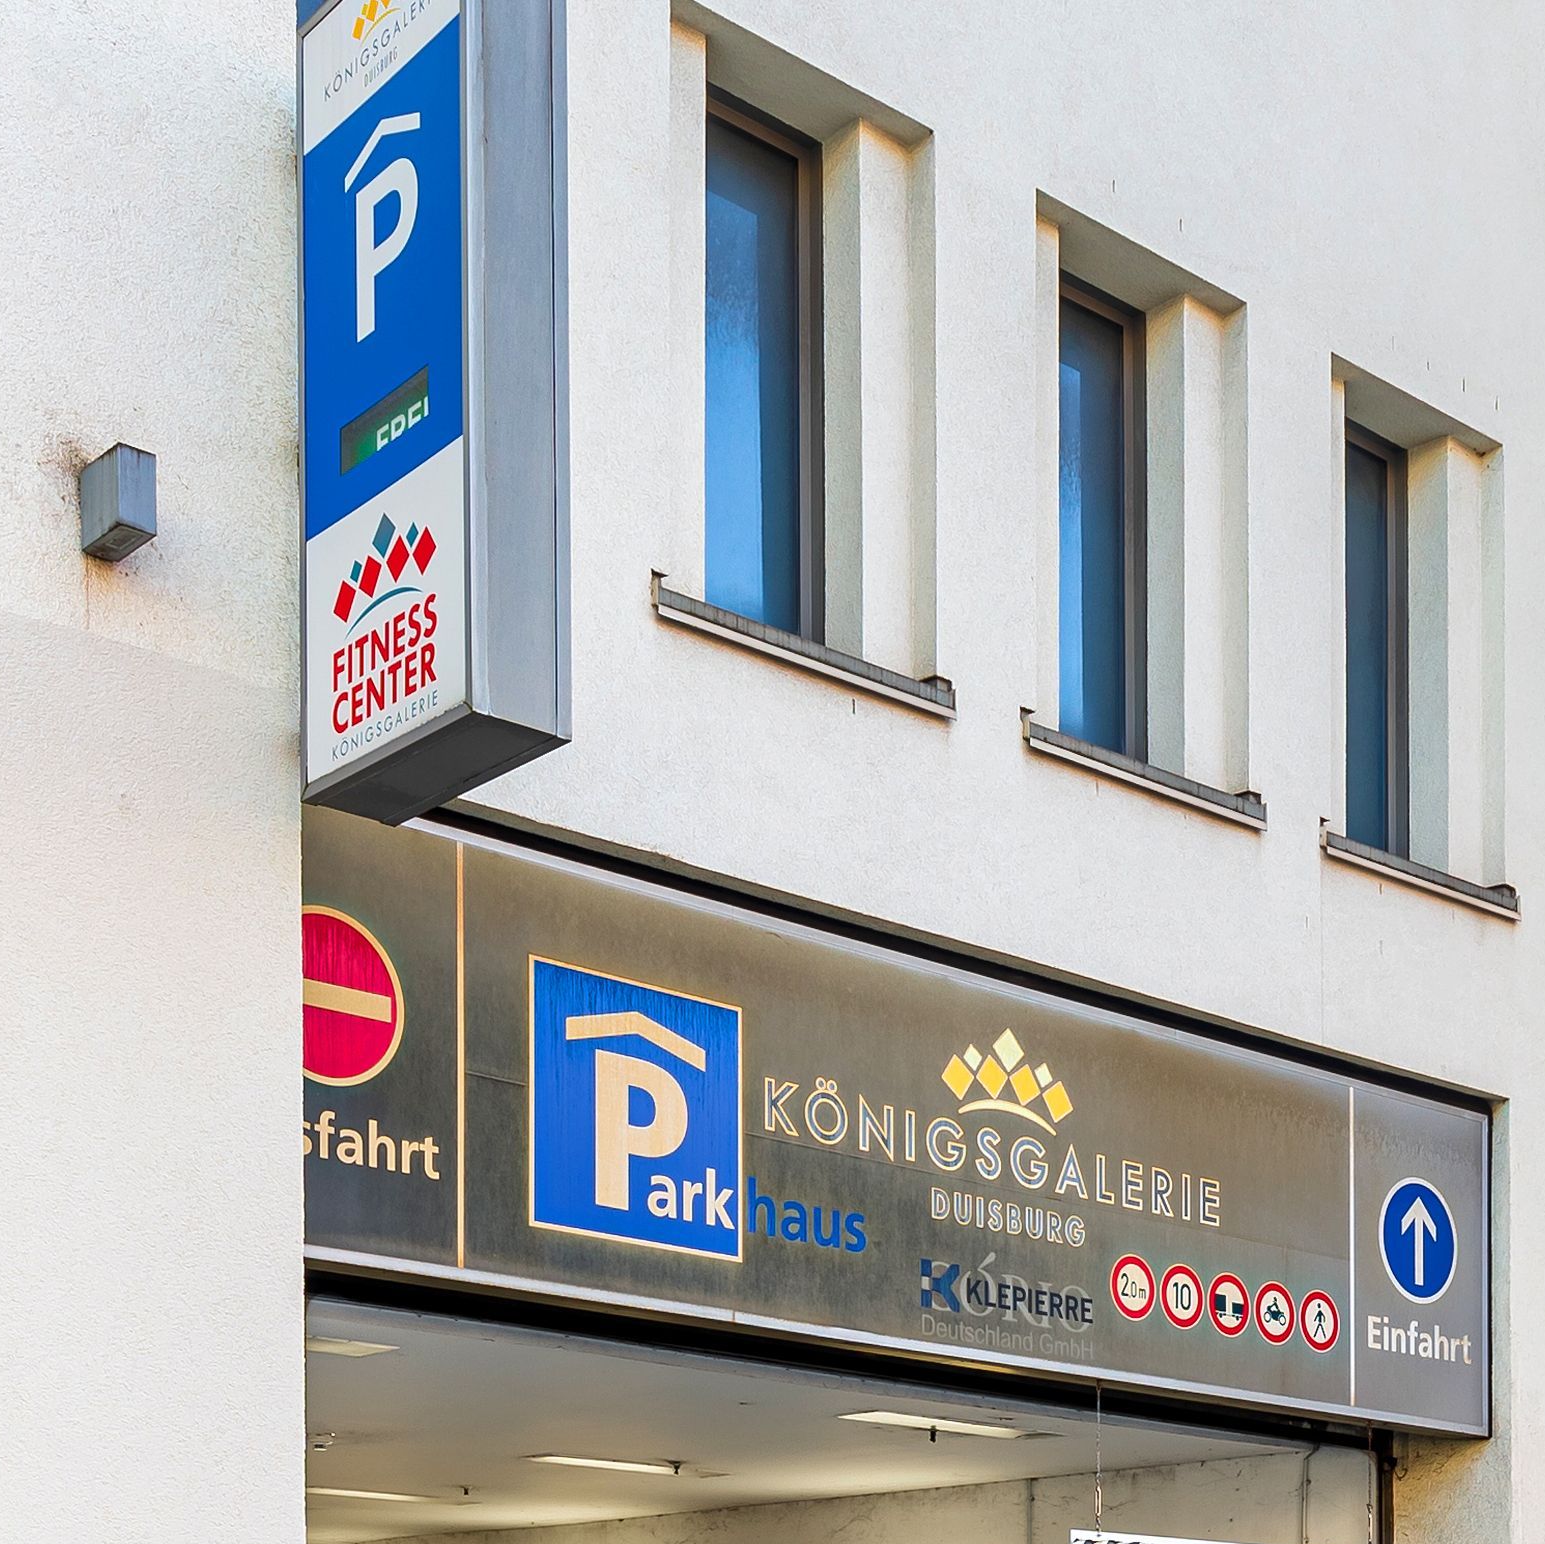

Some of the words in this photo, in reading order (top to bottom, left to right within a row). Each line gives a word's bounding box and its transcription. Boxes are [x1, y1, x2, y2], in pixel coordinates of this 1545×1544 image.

[363, 46, 398, 88] DUISBURG
[356, 157, 419, 343] P
[333, 593, 438, 692] FITNESS
[332, 643, 437, 734] CENTER
[332, 689, 439, 762] KÖNIGSGALERIE
[764, 1076, 1222, 1228] KÖNIGSGALERIE
[931, 1186, 1087, 1248] DUISBURG
[966, 1277, 1094, 1324] KLEPIERRE
[1173, 1281, 1192, 1311] 10
[921, 1313, 1033, 1350] Deutschland
[1039, 1333, 1094, 1360] GmbH
[1367, 1315, 1472, 1365] Einfahrt
